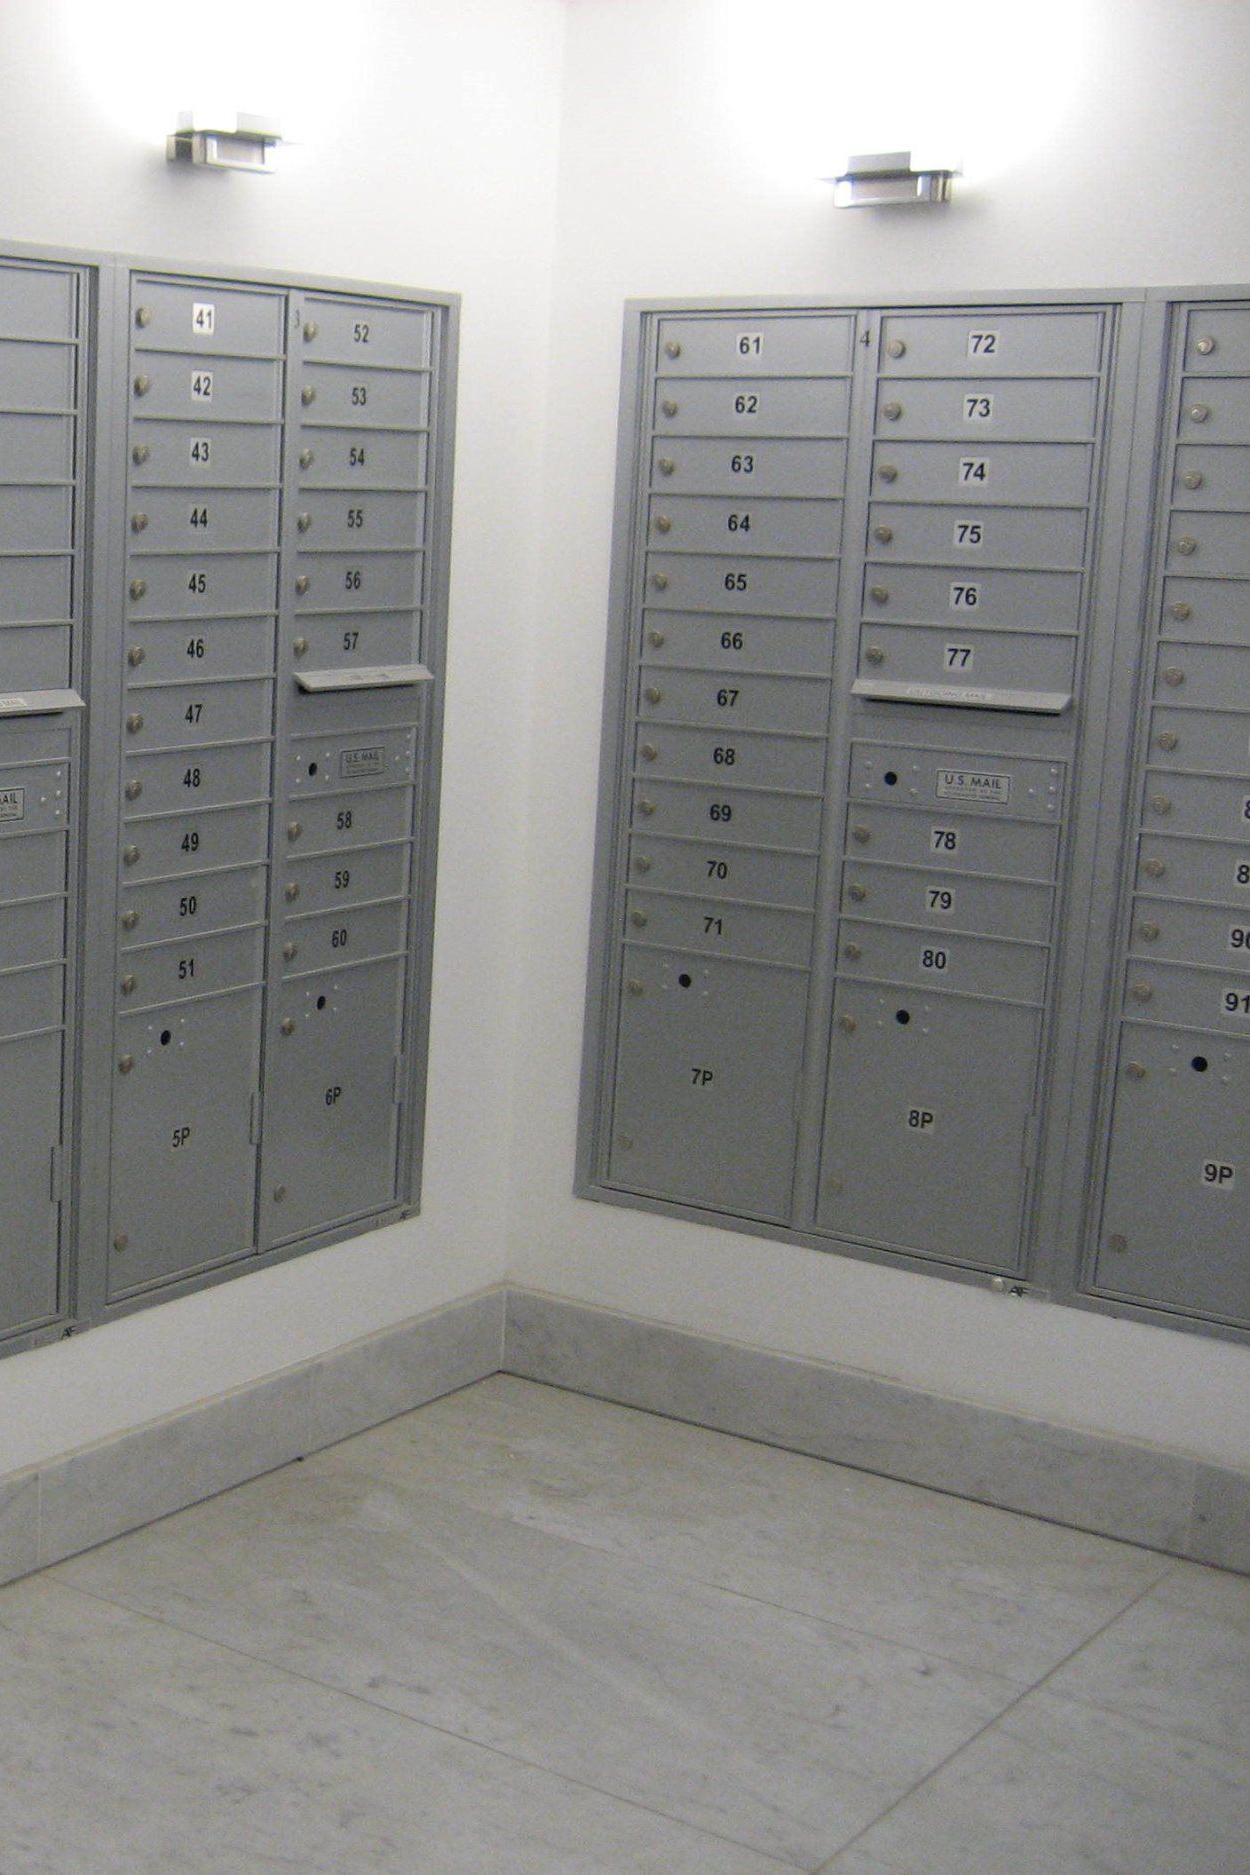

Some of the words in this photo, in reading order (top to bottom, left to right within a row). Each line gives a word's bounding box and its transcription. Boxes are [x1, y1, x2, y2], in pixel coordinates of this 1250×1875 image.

[196, 309, 212, 329] 41
[353, 323, 370, 344] 52
[859, 329, 871, 347] 4
[739, 336, 761, 355] 61
[972, 334, 996, 354] 72
[193, 376, 211, 397] 42
[351, 386, 368, 407] 53
[734, 395, 758, 414] 62
[967, 398, 991, 418] 73
[191, 442, 209, 462] 43
[349, 447, 365, 467] 54
[730, 454, 754, 474] 63
[963, 462, 986, 481] 74
[189, 508, 208, 528] 44
[347, 508, 364, 529] 55
[727, 513, 751, 532] 64
[958, 524, 982, 544] 75
[188, 573, 207, 594] 45
[345, 570, 362, 591] 56
[724, 572, 748, 592] 65
[954, 586, 977, 606] 76
[186, 638, 205, 659] 46
[343, 631, 360, 651] 57
[720, 631, 744, 650] 66
[948, 648, 971, 667] 77
[716, 688, 740, 707] 67
[184, 703, 203, 724] 47
[712, 747, 736, 766] 68
[182, 768, 201, 788] 48
[970, 776, 1002, 790] MAIL
[336, 810, 353, 831] 58
[709, 803, 733, 823] 69
[180, 832, 200, 853] 49
[934, 830, 956, 851] 78
[334, 869, 351, 890] 59
[707, 860, 728, 880] 70
[179, 895, 198, 917] 50
[929, 890, 952, 910] 79
[703, 916, 723, 936] 71
[331, 928, 348, 949] 60
[178, 958, 195, 980] 51
[922, 949, 947, 970] 80
[1225, 992, 1250, 1013] 91
[691, 1067, 714, 1086] 7P
[325, 1085, 342, 1106] 6P
[908, 1109, 934, 1129] 8P
[172, 1126, 191, 1148] 5P
[1204, 1163, 1233, 1184] 9P
